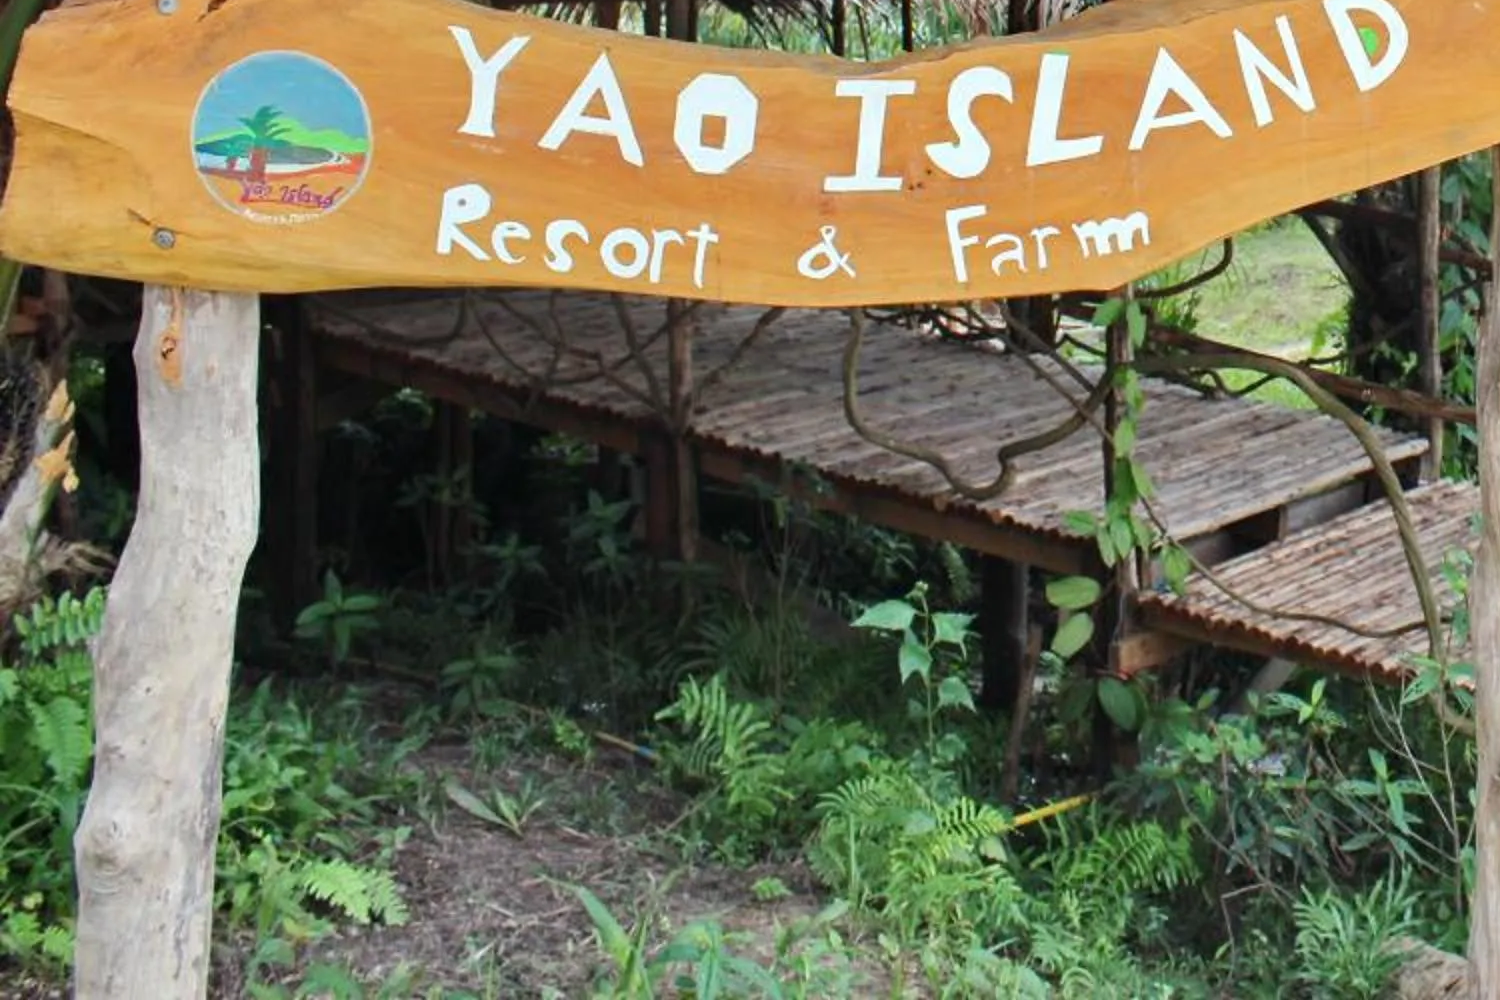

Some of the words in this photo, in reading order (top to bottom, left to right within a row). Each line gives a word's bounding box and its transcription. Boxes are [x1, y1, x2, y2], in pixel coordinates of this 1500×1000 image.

[447, 25, 759, 174] YAO
[436, 183, 719, 288] Resort
[797, 224, 857, 280] &
[945, 204, 1150, 283] Farm
